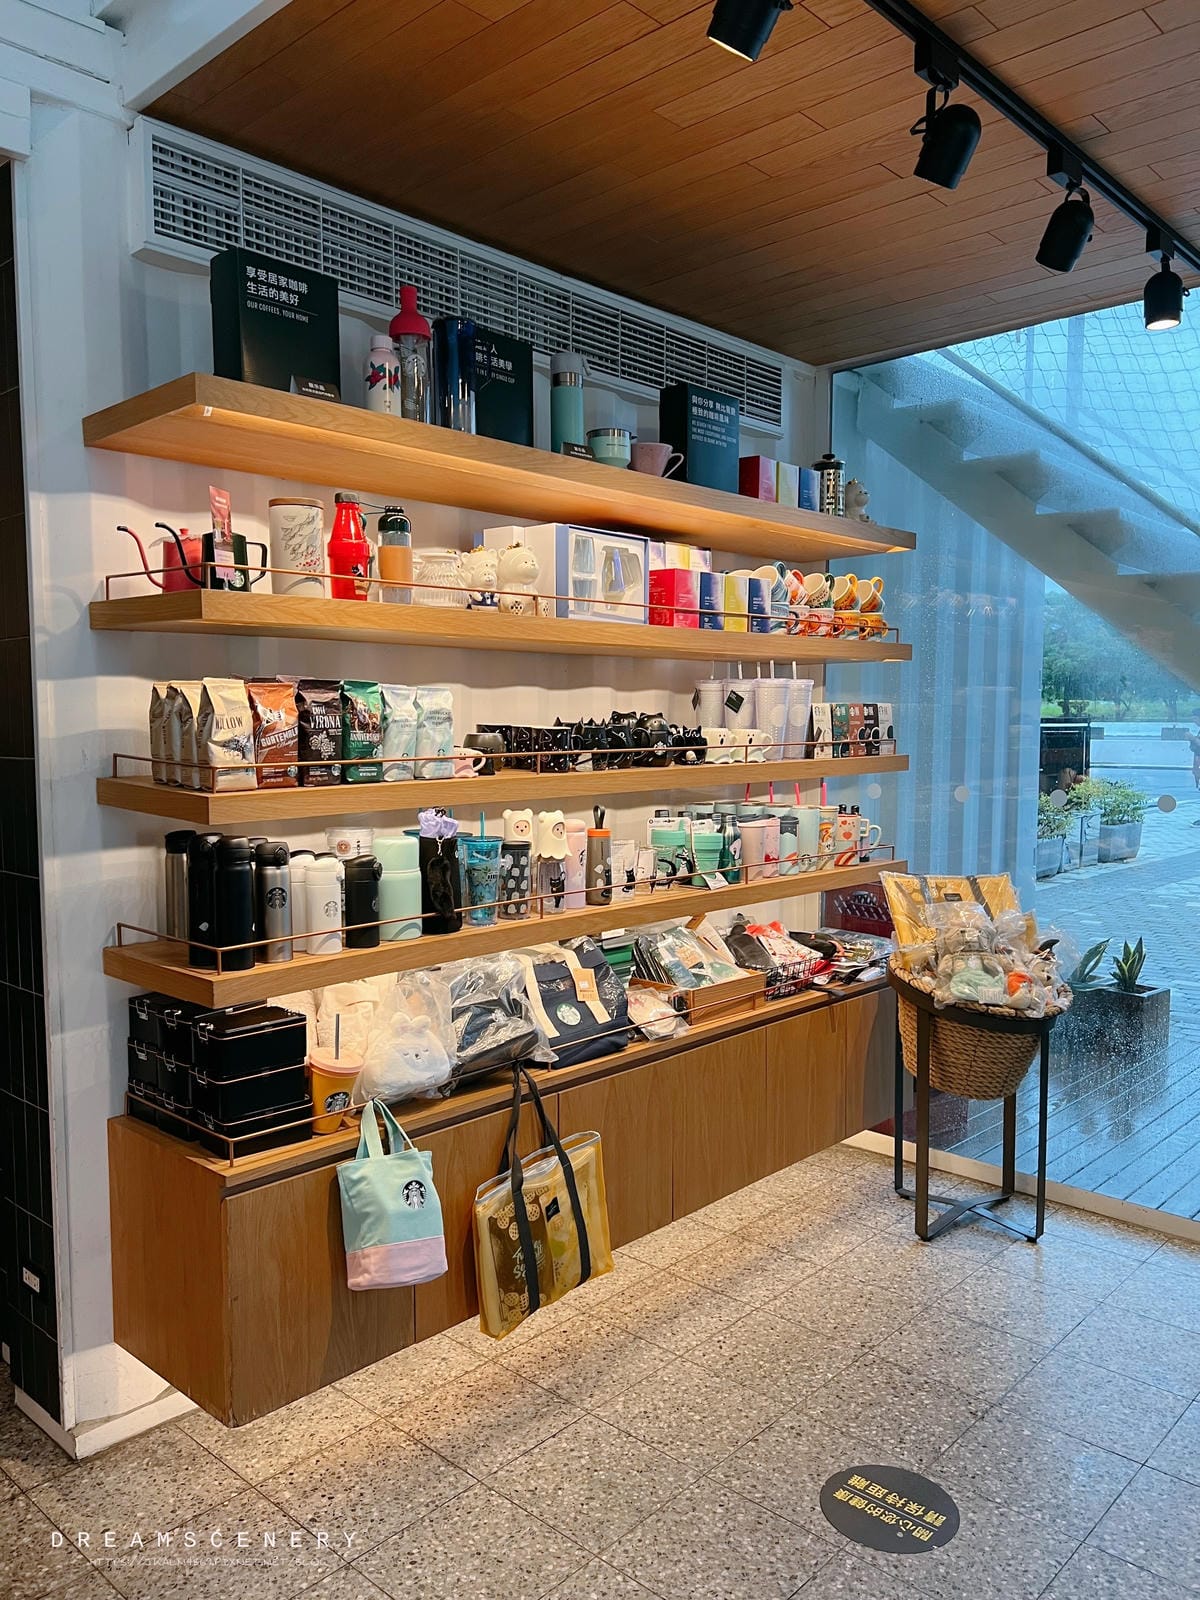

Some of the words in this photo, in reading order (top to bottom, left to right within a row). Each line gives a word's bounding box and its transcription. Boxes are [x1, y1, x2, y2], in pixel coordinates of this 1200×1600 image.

[246, 266, 308, 294] 享受居家咖啡
[246, 300, 258, 310] OUR
[247, 281, 300, 306] 生活的美好
[309, 715, 341, 729] VERONA
[847, 1474, 947, 1527] 請保持距離
[833, 1488, 933, 1542] 關心您的健康
